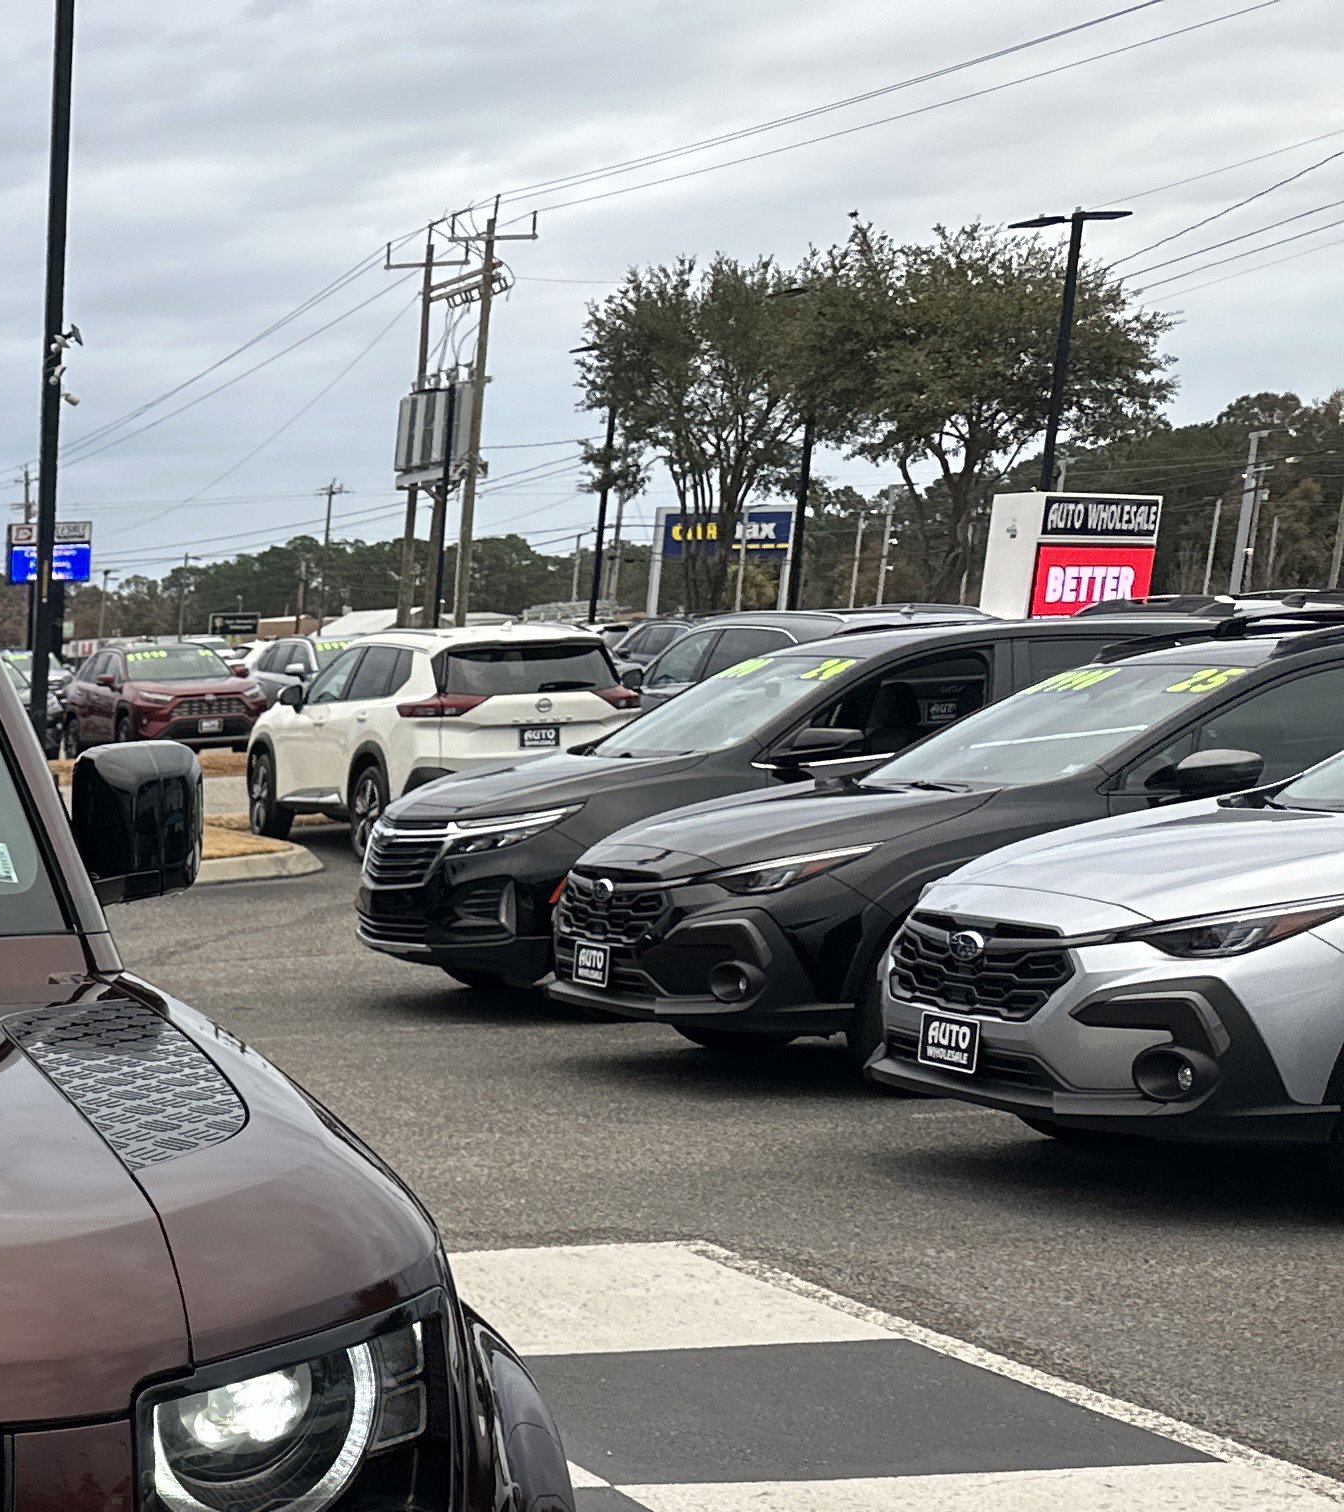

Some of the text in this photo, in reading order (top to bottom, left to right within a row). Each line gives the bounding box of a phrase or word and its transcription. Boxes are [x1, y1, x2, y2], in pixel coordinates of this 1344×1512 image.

[1047, 502, 1158, 532] AUTO WHOLESALE
[1045, 565, 1136, 603] BETTER
[1165, 668, 1246, 693] 25
[524, 728, 556, 741] AUTO
[578, 948, 604, 969] AUTO
[928, 1021, 971, 1050] AUTO
